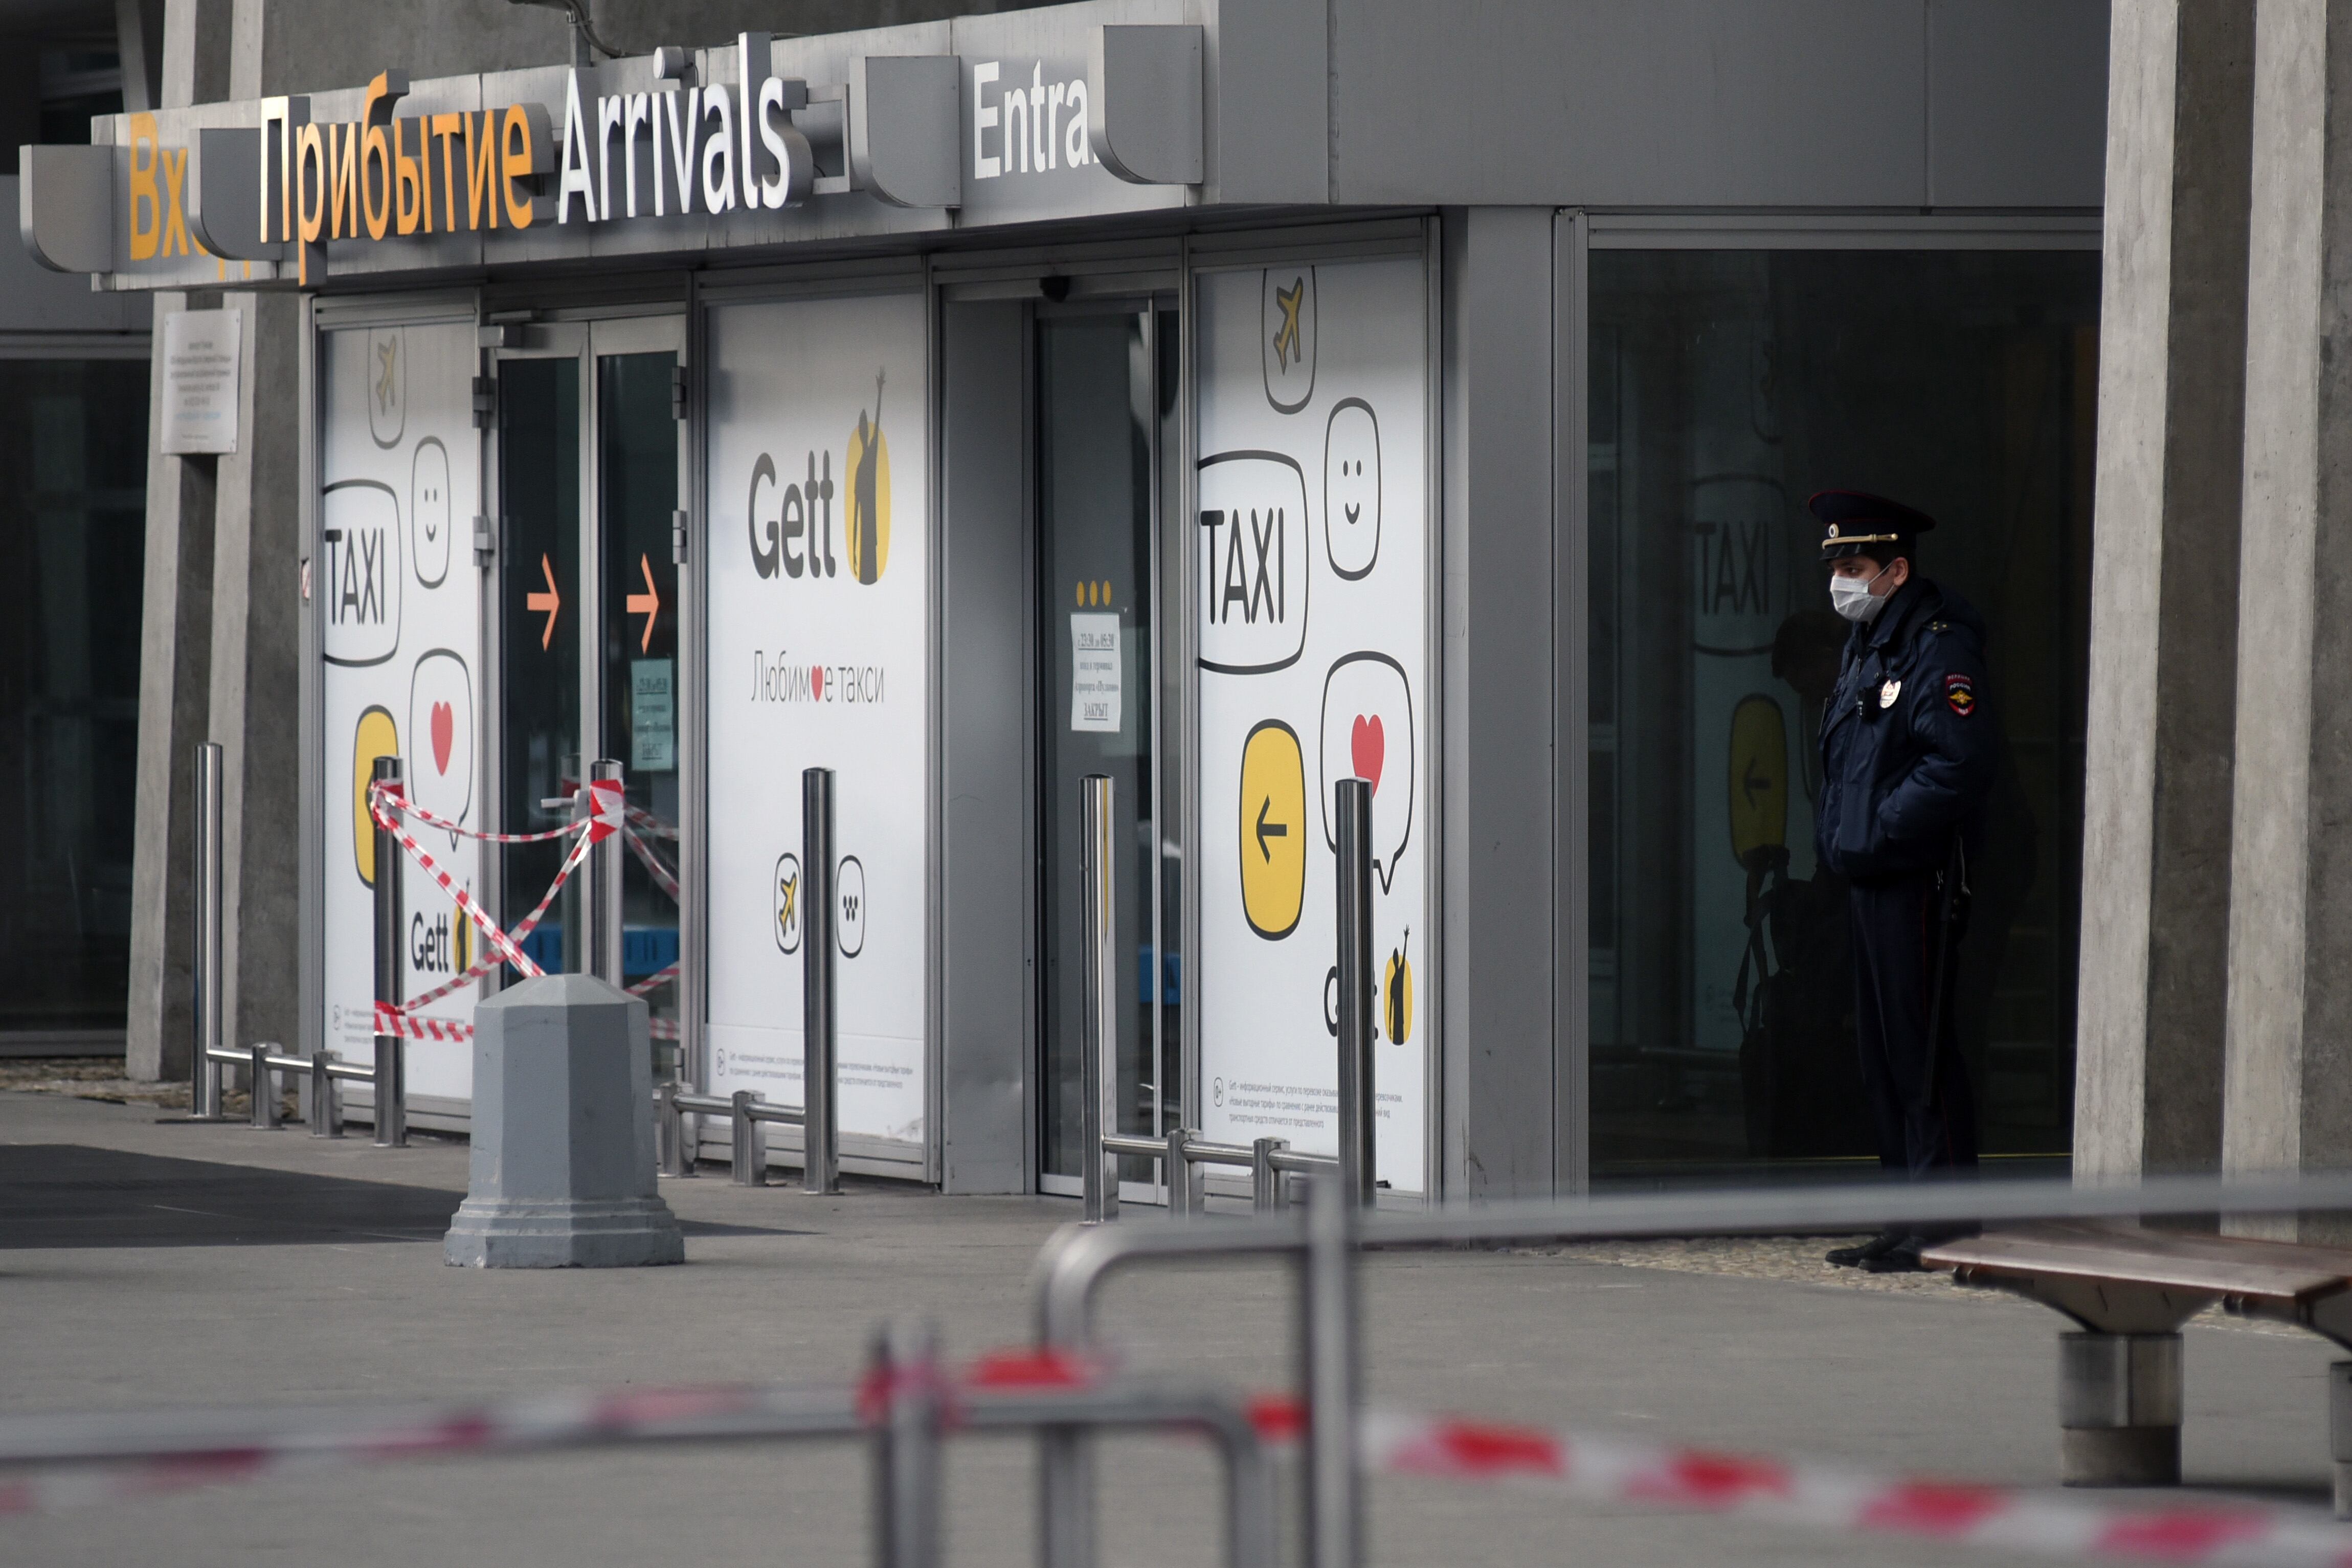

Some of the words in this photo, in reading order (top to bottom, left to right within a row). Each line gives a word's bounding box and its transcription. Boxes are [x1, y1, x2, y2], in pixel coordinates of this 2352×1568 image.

[558, 32, 791, 224] Arrivals
[974, 59, 1101, 180] Entra
[260, 69, 533, 286] Прибытие
[748, 449, 836, 580] Gett
[325, 527, 385, 625] TAXI
[1200, 507, 1285, 625] TAXI
[1694, 520, 1769, 615] TAXI
[838, 665, 884, 703] такси
[1084, 702, 1108, 717] ЗАКРЫТ
[1950, 683, 1971, 691] РОССИЯ
[411, 911, 449, 973] Gett
